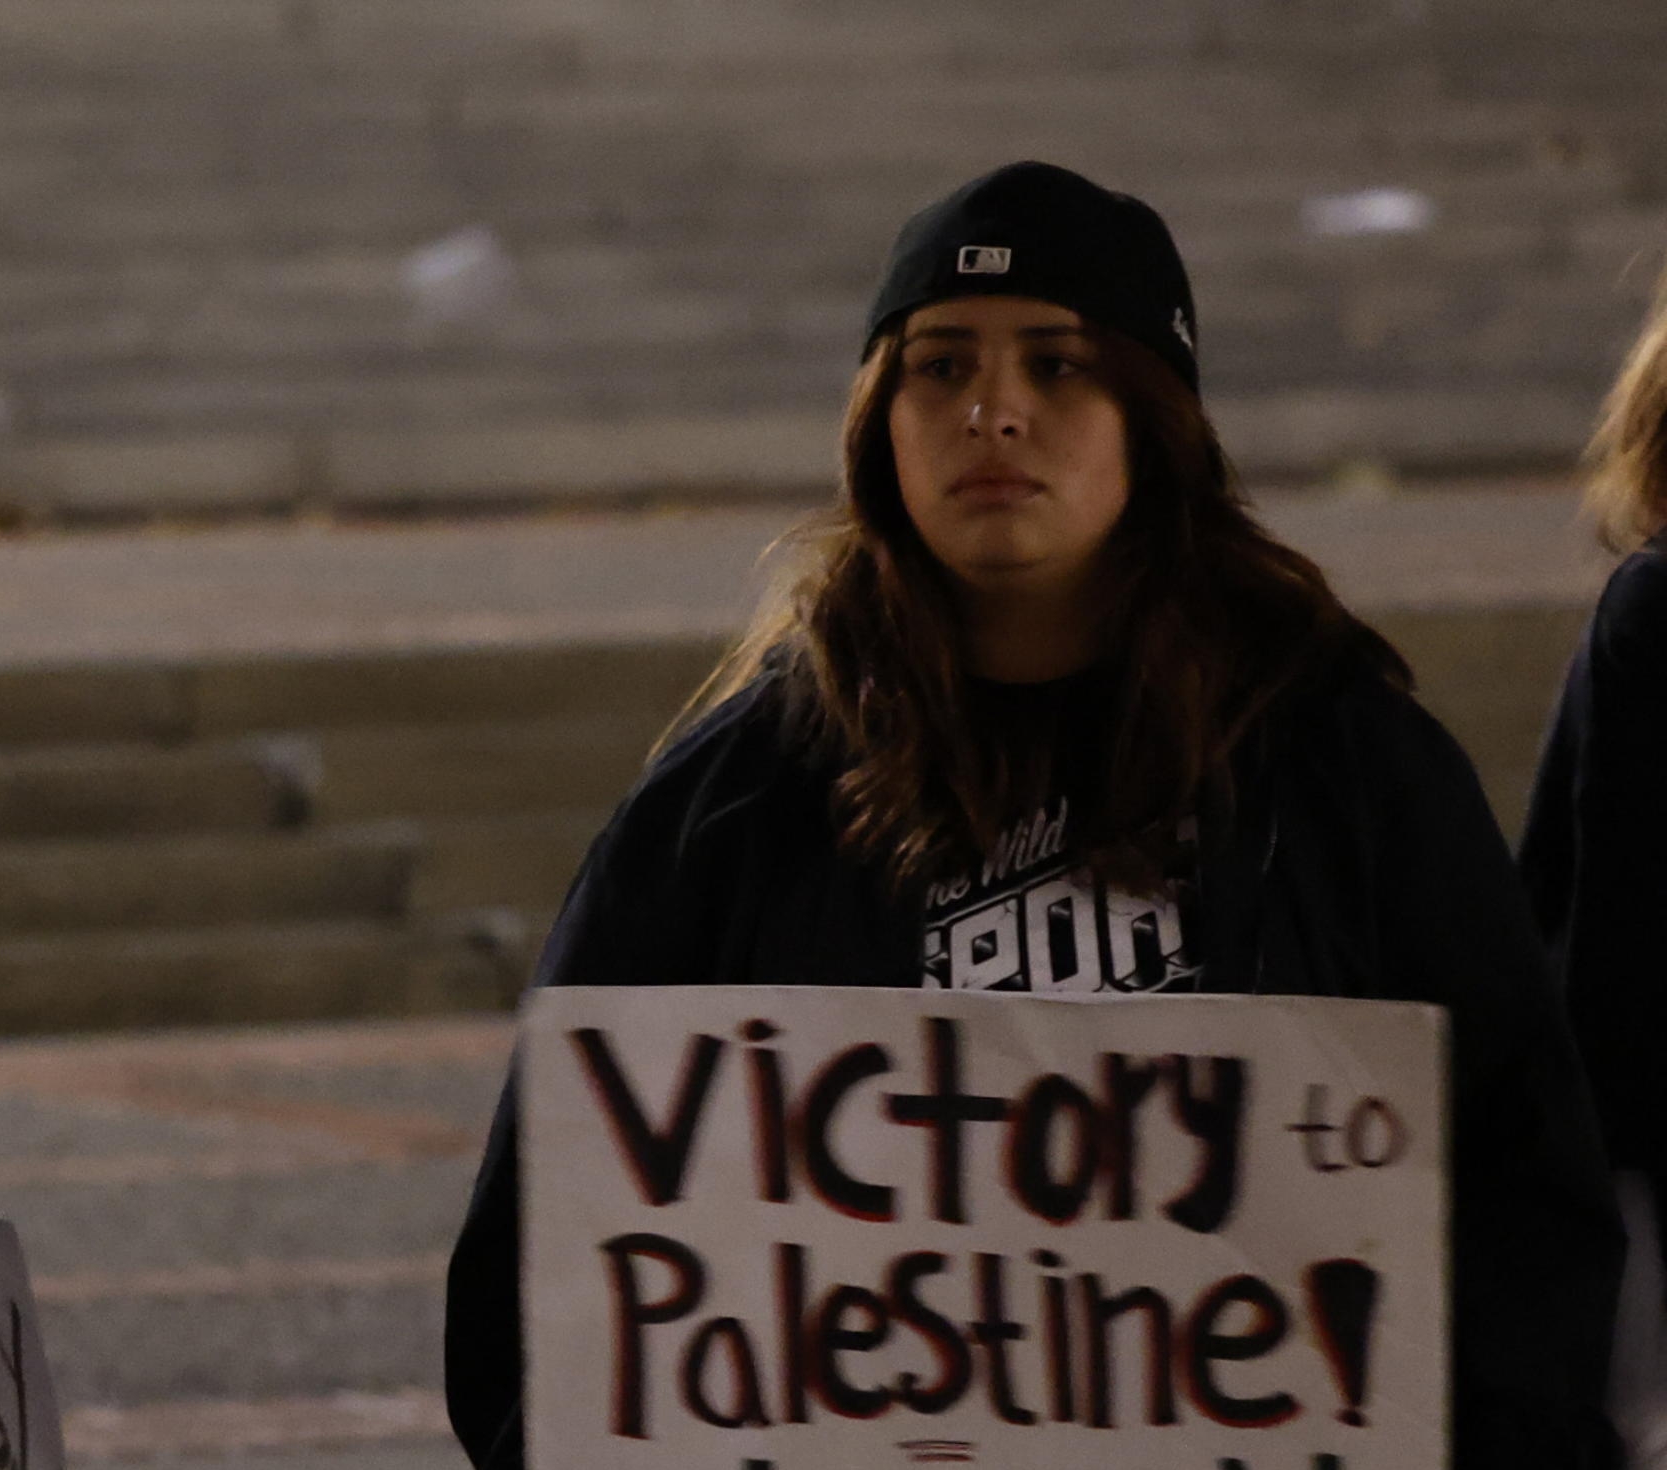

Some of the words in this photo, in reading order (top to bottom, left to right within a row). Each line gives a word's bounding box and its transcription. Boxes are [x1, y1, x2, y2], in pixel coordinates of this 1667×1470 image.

[569, 1014, 1249, 1234] Victory
[1284, 1083, 1414, 1173] to
[598, 1231, 1381, 1441] Palestine!
